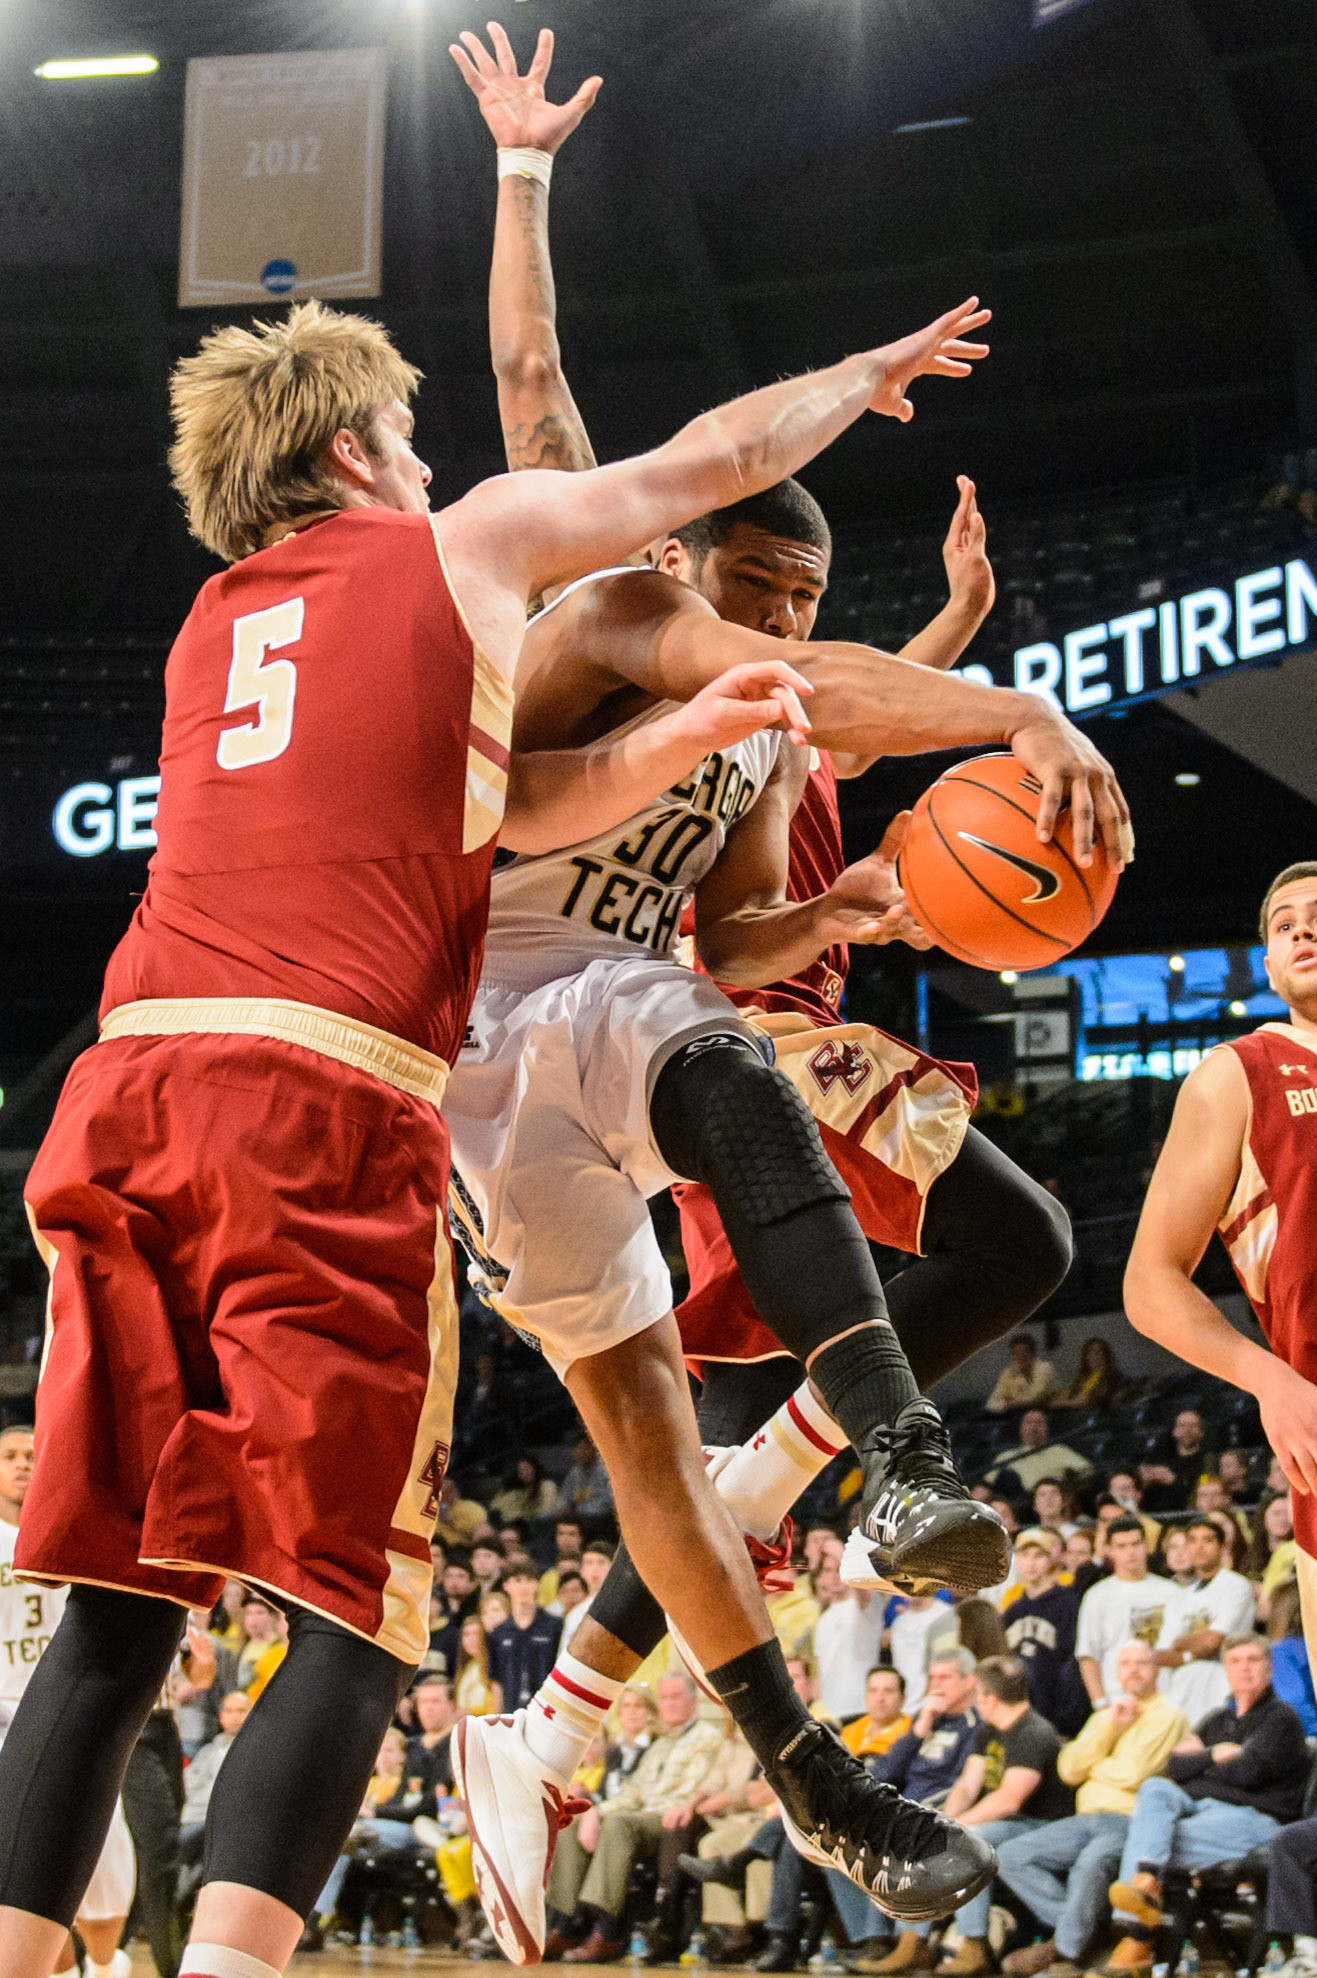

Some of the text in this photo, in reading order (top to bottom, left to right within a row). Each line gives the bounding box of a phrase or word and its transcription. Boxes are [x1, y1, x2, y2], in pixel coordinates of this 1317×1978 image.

[244, 135, 322, 179] 2012
[216, 596, 305, 771] 5
[612, 808, 714, 886] 30
[560, 855, 684, 954] TECH
[1284, 1086, 1317, 1117] BO
[24, 1594, 43, 1629] 3
